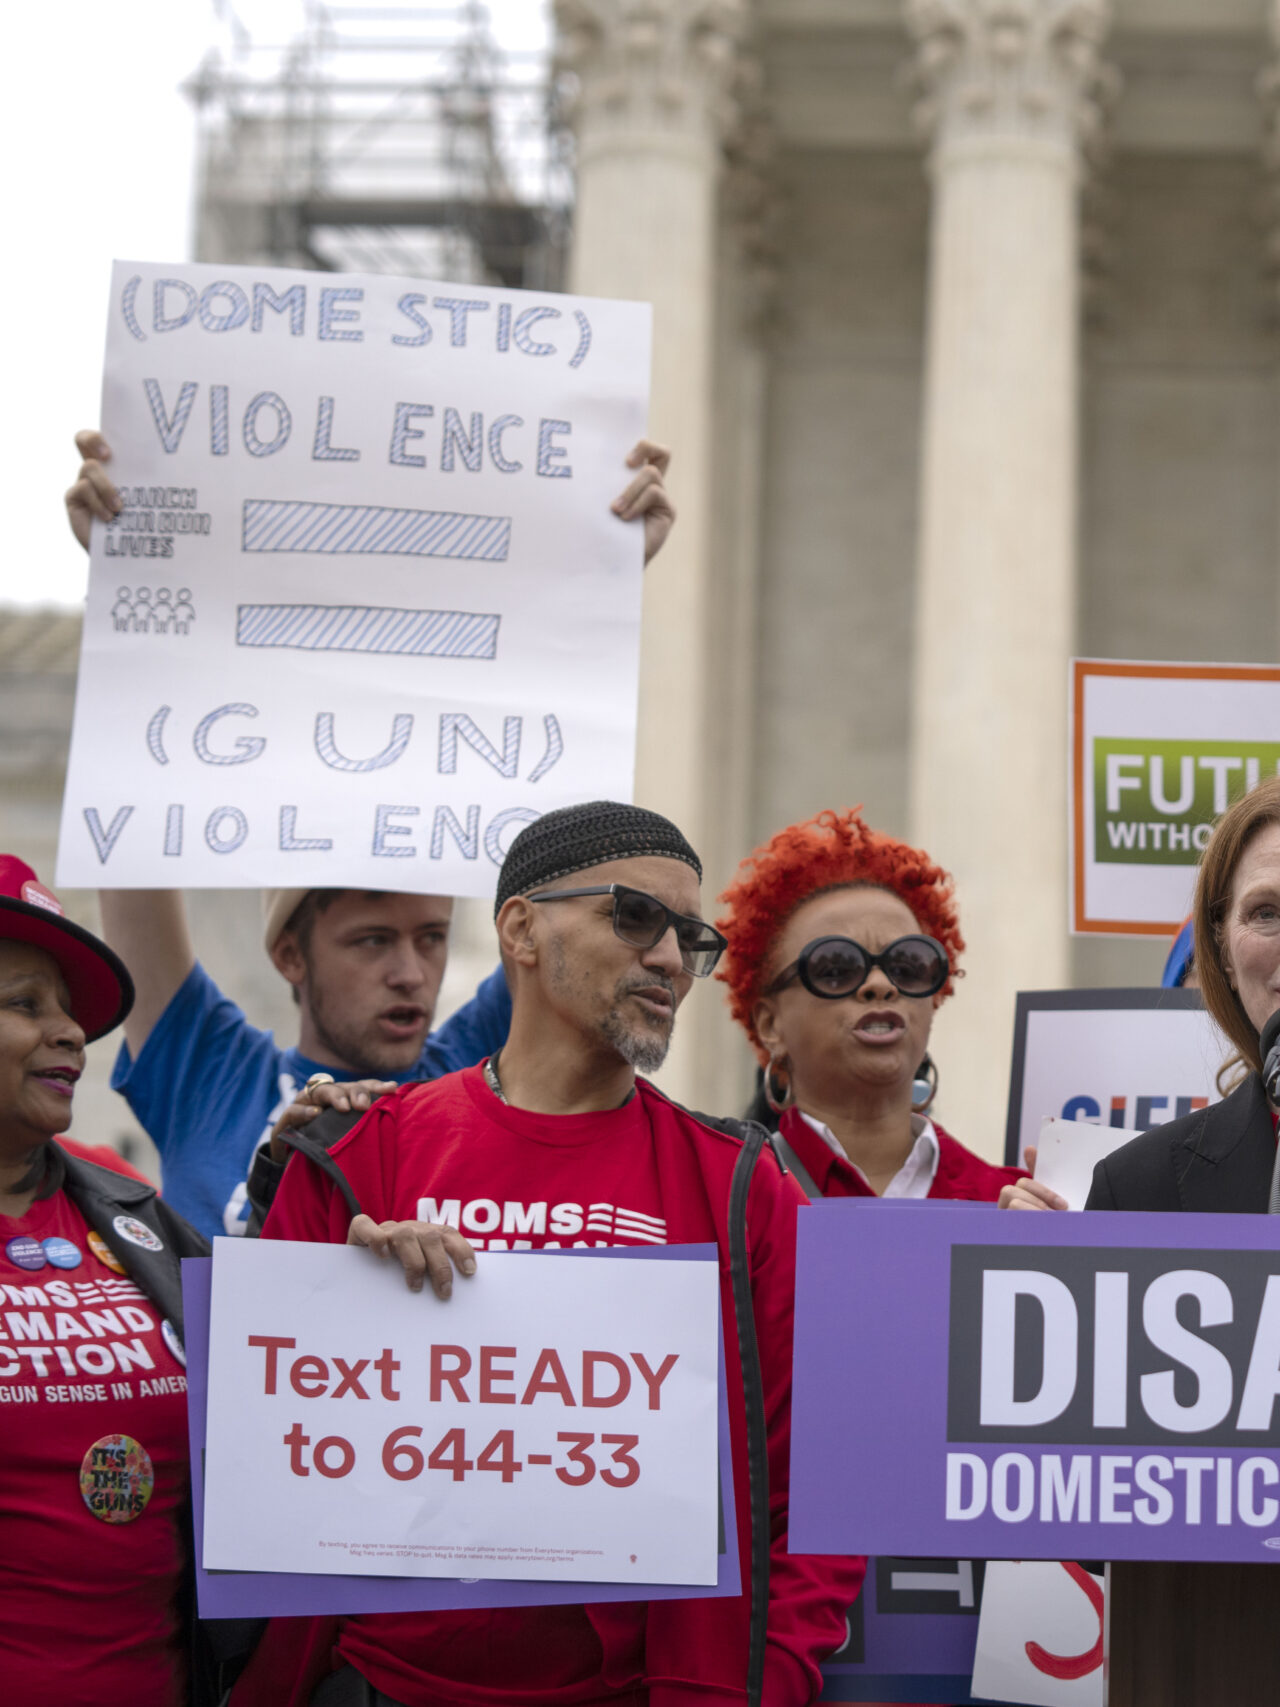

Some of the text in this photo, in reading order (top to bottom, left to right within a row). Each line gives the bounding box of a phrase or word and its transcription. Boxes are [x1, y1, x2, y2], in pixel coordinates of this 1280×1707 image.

[417, 1197, 584, 1235] MOMS
[248, 1335, 680, 1412] Text READY
[45, 1384, 108, 1403] SENSE
[111, 1382, 133, 1400] IN
[92, 1447, 126, 1468] IT'S
[284, 1422, 642, 1489] to 644-33
[91, 1469, 129, 1489] THE
[945, 1452, 1279, 1527] DOMESTIC
[90, 1491, 145, 1512] GUNS
